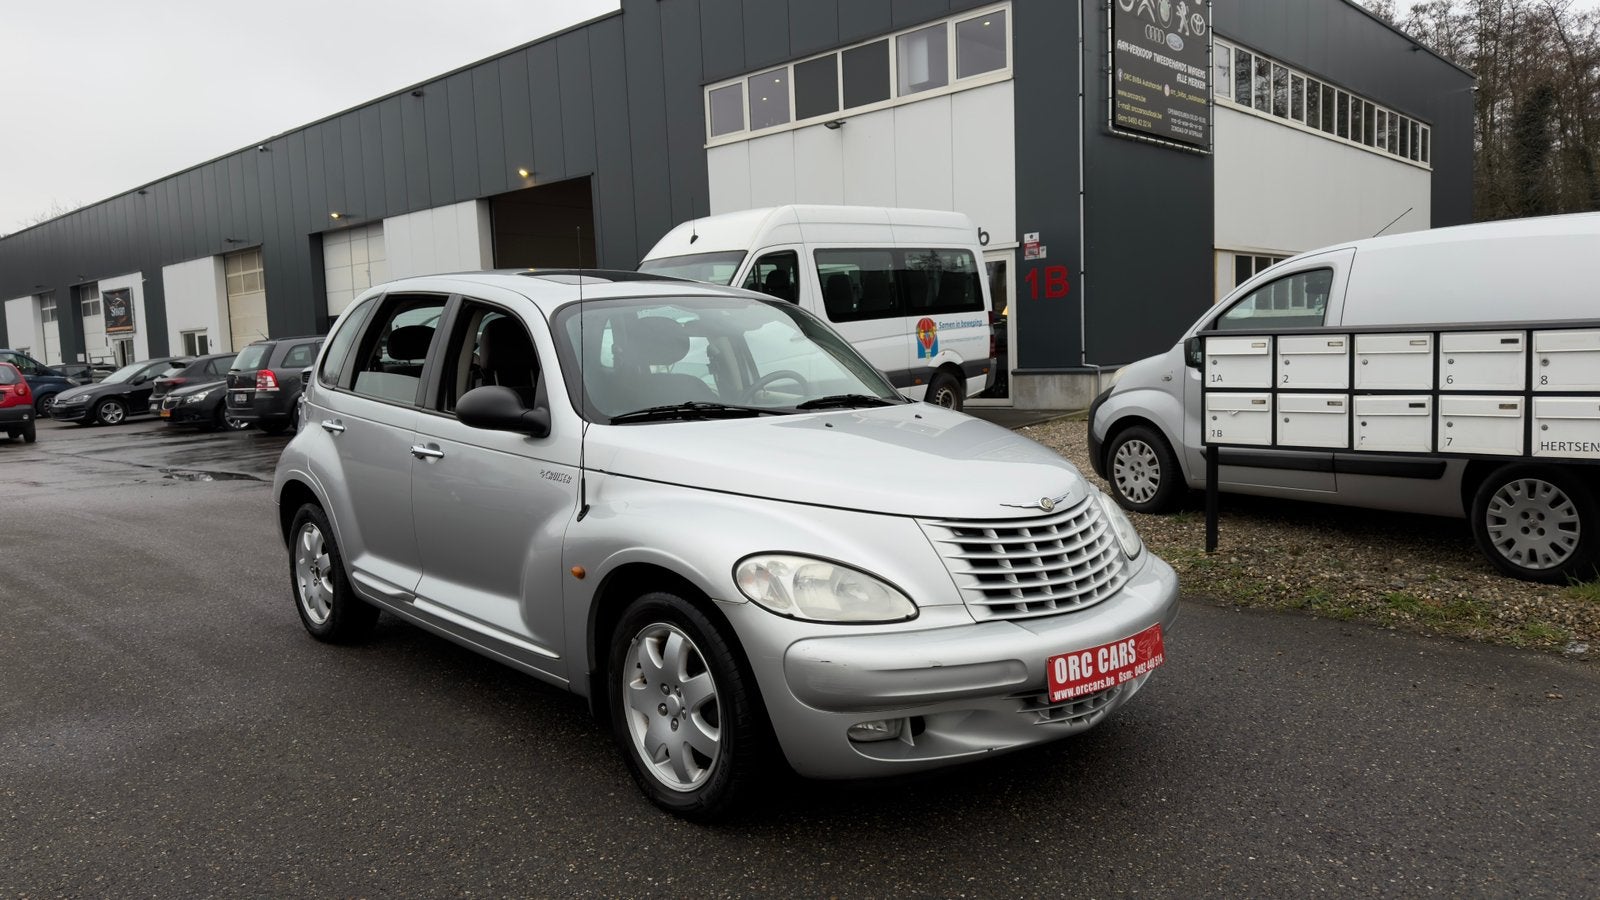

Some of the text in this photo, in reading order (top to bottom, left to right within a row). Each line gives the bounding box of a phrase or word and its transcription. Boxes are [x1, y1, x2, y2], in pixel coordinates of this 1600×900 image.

[1116, 40, 1152, 59] AAN-VERKOOP
[1153, 53, 1187, 72] TWEEDEHANDS
[1187, 65, 1206, 79] WAGENS
[1176, 74, 1206, 90] ALLE MERKEN
[1025, 265, 1070, 300] 1B
[1211, 374, 1223, 382] 1A
[1283, 375, 1289, 383] 2
[1446, 375, 1454, 384] 6
[1540, 375, 1548, 385] 8
[1446, 437, 1453, 446] 7
[1054, 639, 1136, 684] ORC CARS
[1054, 676, 1115, 701] www.orccars.be
[1118, 671, 1133, 683] Gsm:
